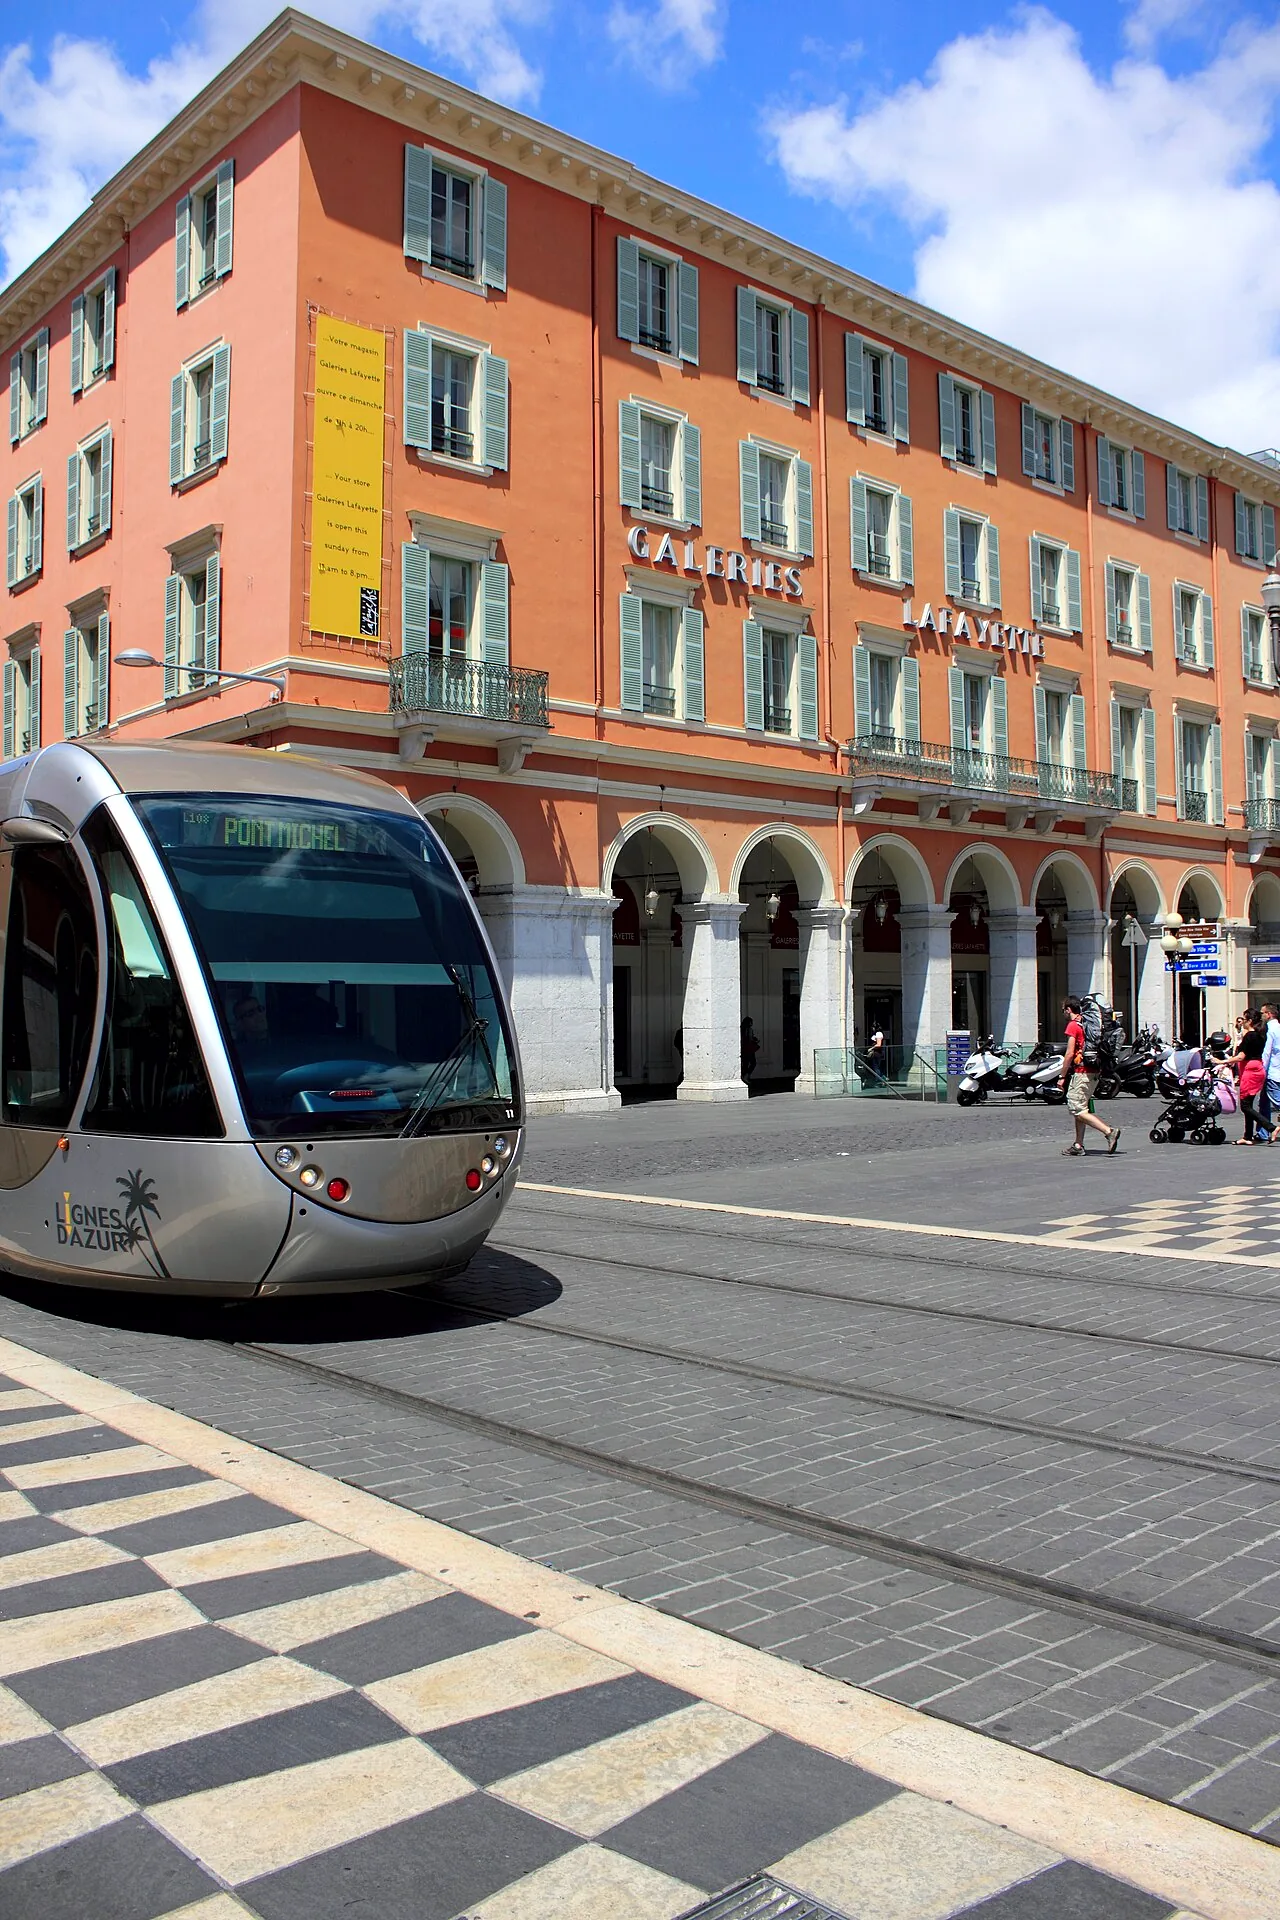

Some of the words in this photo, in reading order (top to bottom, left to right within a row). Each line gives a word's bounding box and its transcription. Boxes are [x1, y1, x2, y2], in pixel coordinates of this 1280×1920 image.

[350, 342, 379, 356] magasin
[319, 359, 347, 373] Galeries
[349, 367, 380, 382] Lafayette
[316, 387, 337, 397] ouvre
[348, 395, 382, 410] dimanche
[334, 472, 351, 482] Your
[353, 479, 370, 488] store
[316, 493, 345, 506] Galeries
[347, 500, 378, 513] Lafayette
[335, 523, 352, 532] open
[354, 526, 368, 535] this
[324, 543, 349, 554] sunday
[351, 547, 369, 557] from
[340, 567, 348, 575] to
[627, 525, 803, 597] GALERIES
[902, 597, 1046, 658] LAFAYETTE
[224, 817, 277, 847] PONT
[278, 821, 345, 851] MICHEL
